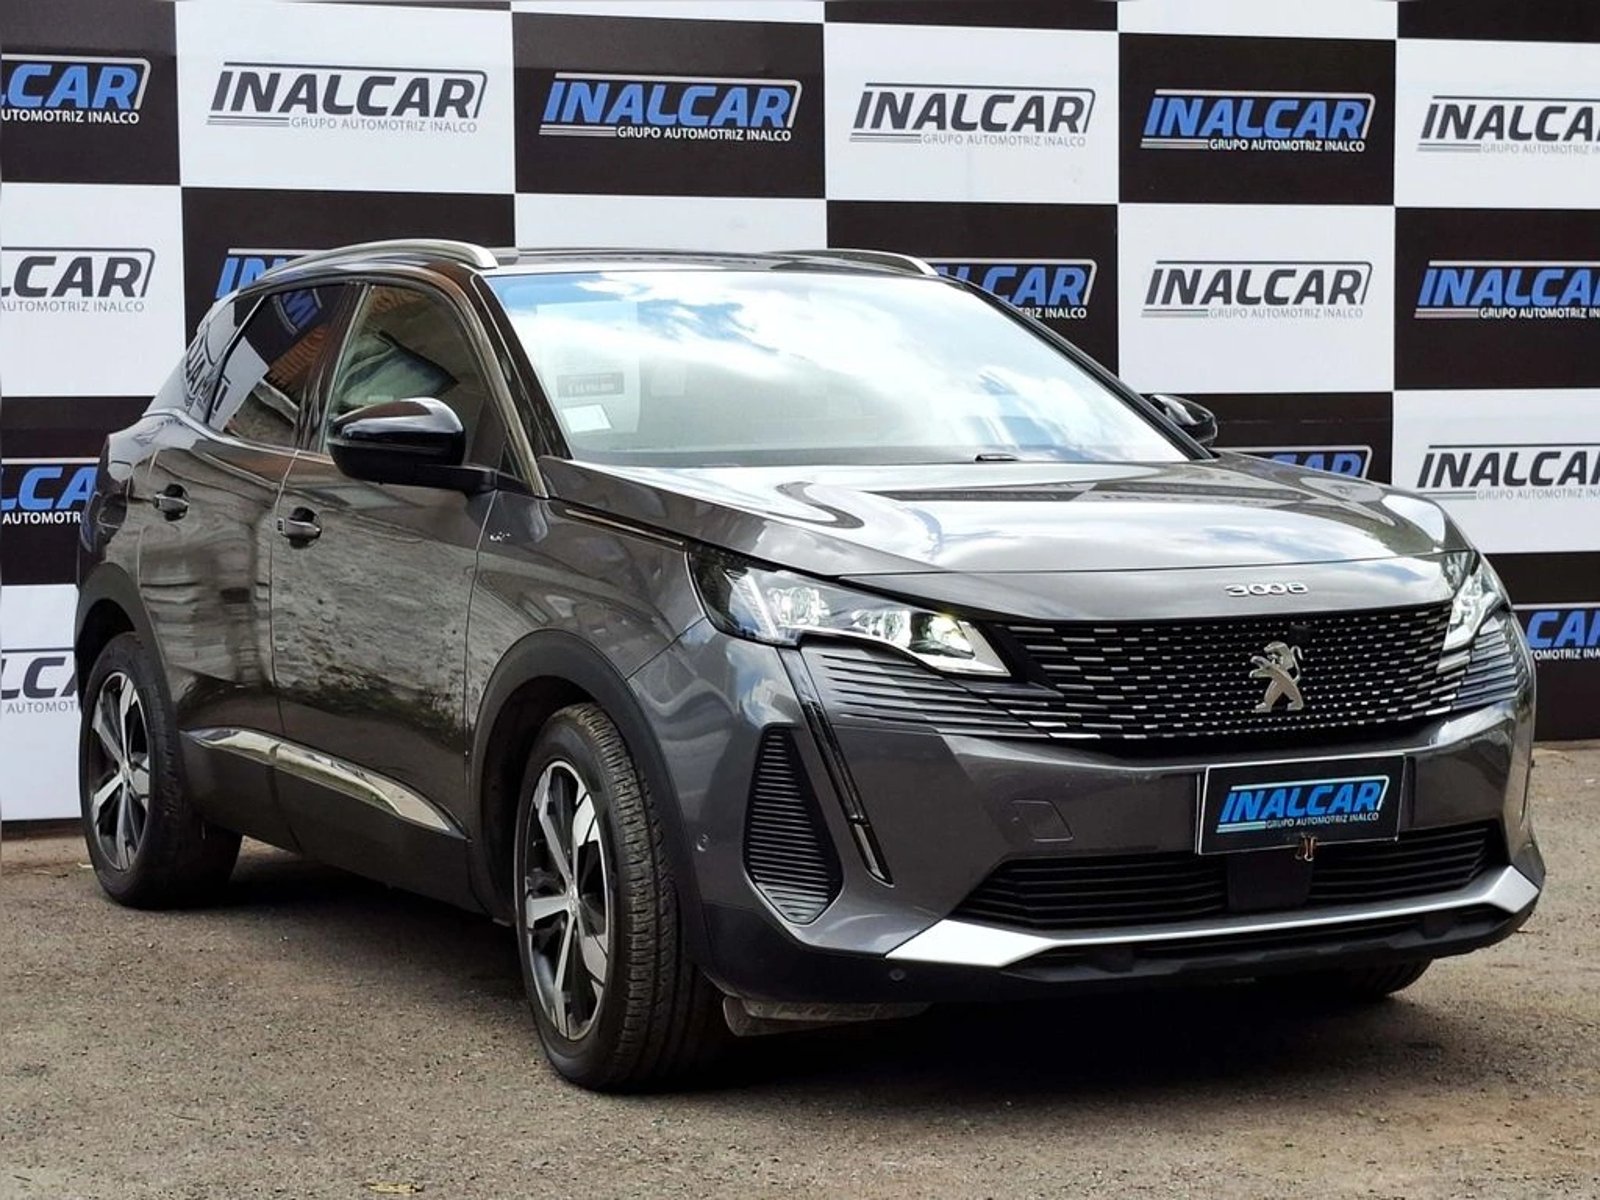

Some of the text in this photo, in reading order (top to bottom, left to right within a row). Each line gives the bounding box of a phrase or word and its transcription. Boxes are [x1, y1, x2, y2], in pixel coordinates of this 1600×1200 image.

[1, 63, 138, 109] CAR
[210, 70, 475, 118] INALCAR
[543, 82, 790, 128] INALCAR
[853, 91, 1084, 133] INALCAR
[1, 109, 140, 124] UTOMOTRIZ INALCO
[1144, 97, 1365, 138] INALCAR
[1421, 104, 1600, 142] INALCA
[291, 117, 477, 133] GRUPO AUTOMOTRIZ INALCO
[617, 126, 791, 141] GRUPO AUTOMOTRIZ INALCO
[923, 134, 1086, 147] GRUPO AUTOMOTRIZ INALCO
[1210, 139, 1365, 152] GRUPO AUTOMOTRIZ INALCO
[1482, 143, 1519, 154] GRUPO
[1145, 269, 1361, 305] INALCAR
[1417, 268, 1600, 307] INALCA
[93, 301, 144, 312] INALCO
[1045, 308, 1087, 319] INALCO
[1210, 308, 1363, 319] GRUPO AUTOMOTRIZ INALCO
[1480, 307, 1517, 318] GRUPO
[1519, 307, 1587, 319] AUTOMOTRIZ
[1417, 451, 1600, 488] INALCA
[1478, 489, 1514, 500] GRUPO
[1517, 487, 1583, 499] AUTOMOTRIZ
[2, 511, 82, 524] AUTOMOTR
[1224, 582, 1308, 597] 3008
[6, 700, 76, 715] AUTOMOT
[1219, 782, 1382, 823] INALCAR
[1266, 811, 1380, 829] GRUPO AUTOMOTRIZ INALCO
